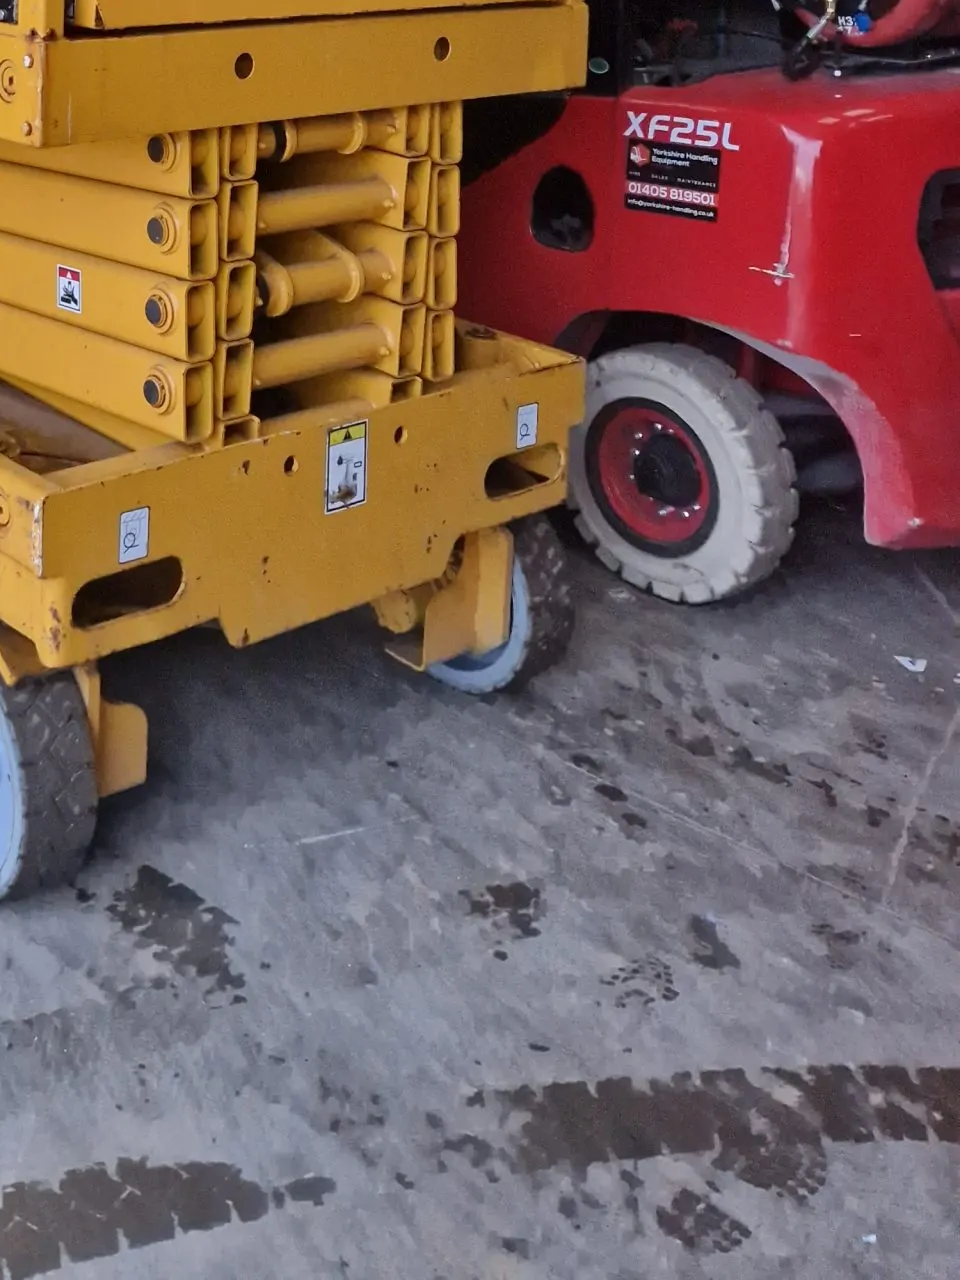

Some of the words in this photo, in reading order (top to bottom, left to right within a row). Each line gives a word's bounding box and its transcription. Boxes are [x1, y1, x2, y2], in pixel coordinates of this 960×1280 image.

[623, 110, 740, 151] XF25L
[652, 148, 685, 159] Yorkshire
[686, 151, 718, 165] Handling
[652, 156, 690, 167] Equipment
[628, 182, 667, 198] 01405
[669, 188, 716, 206] 819501
